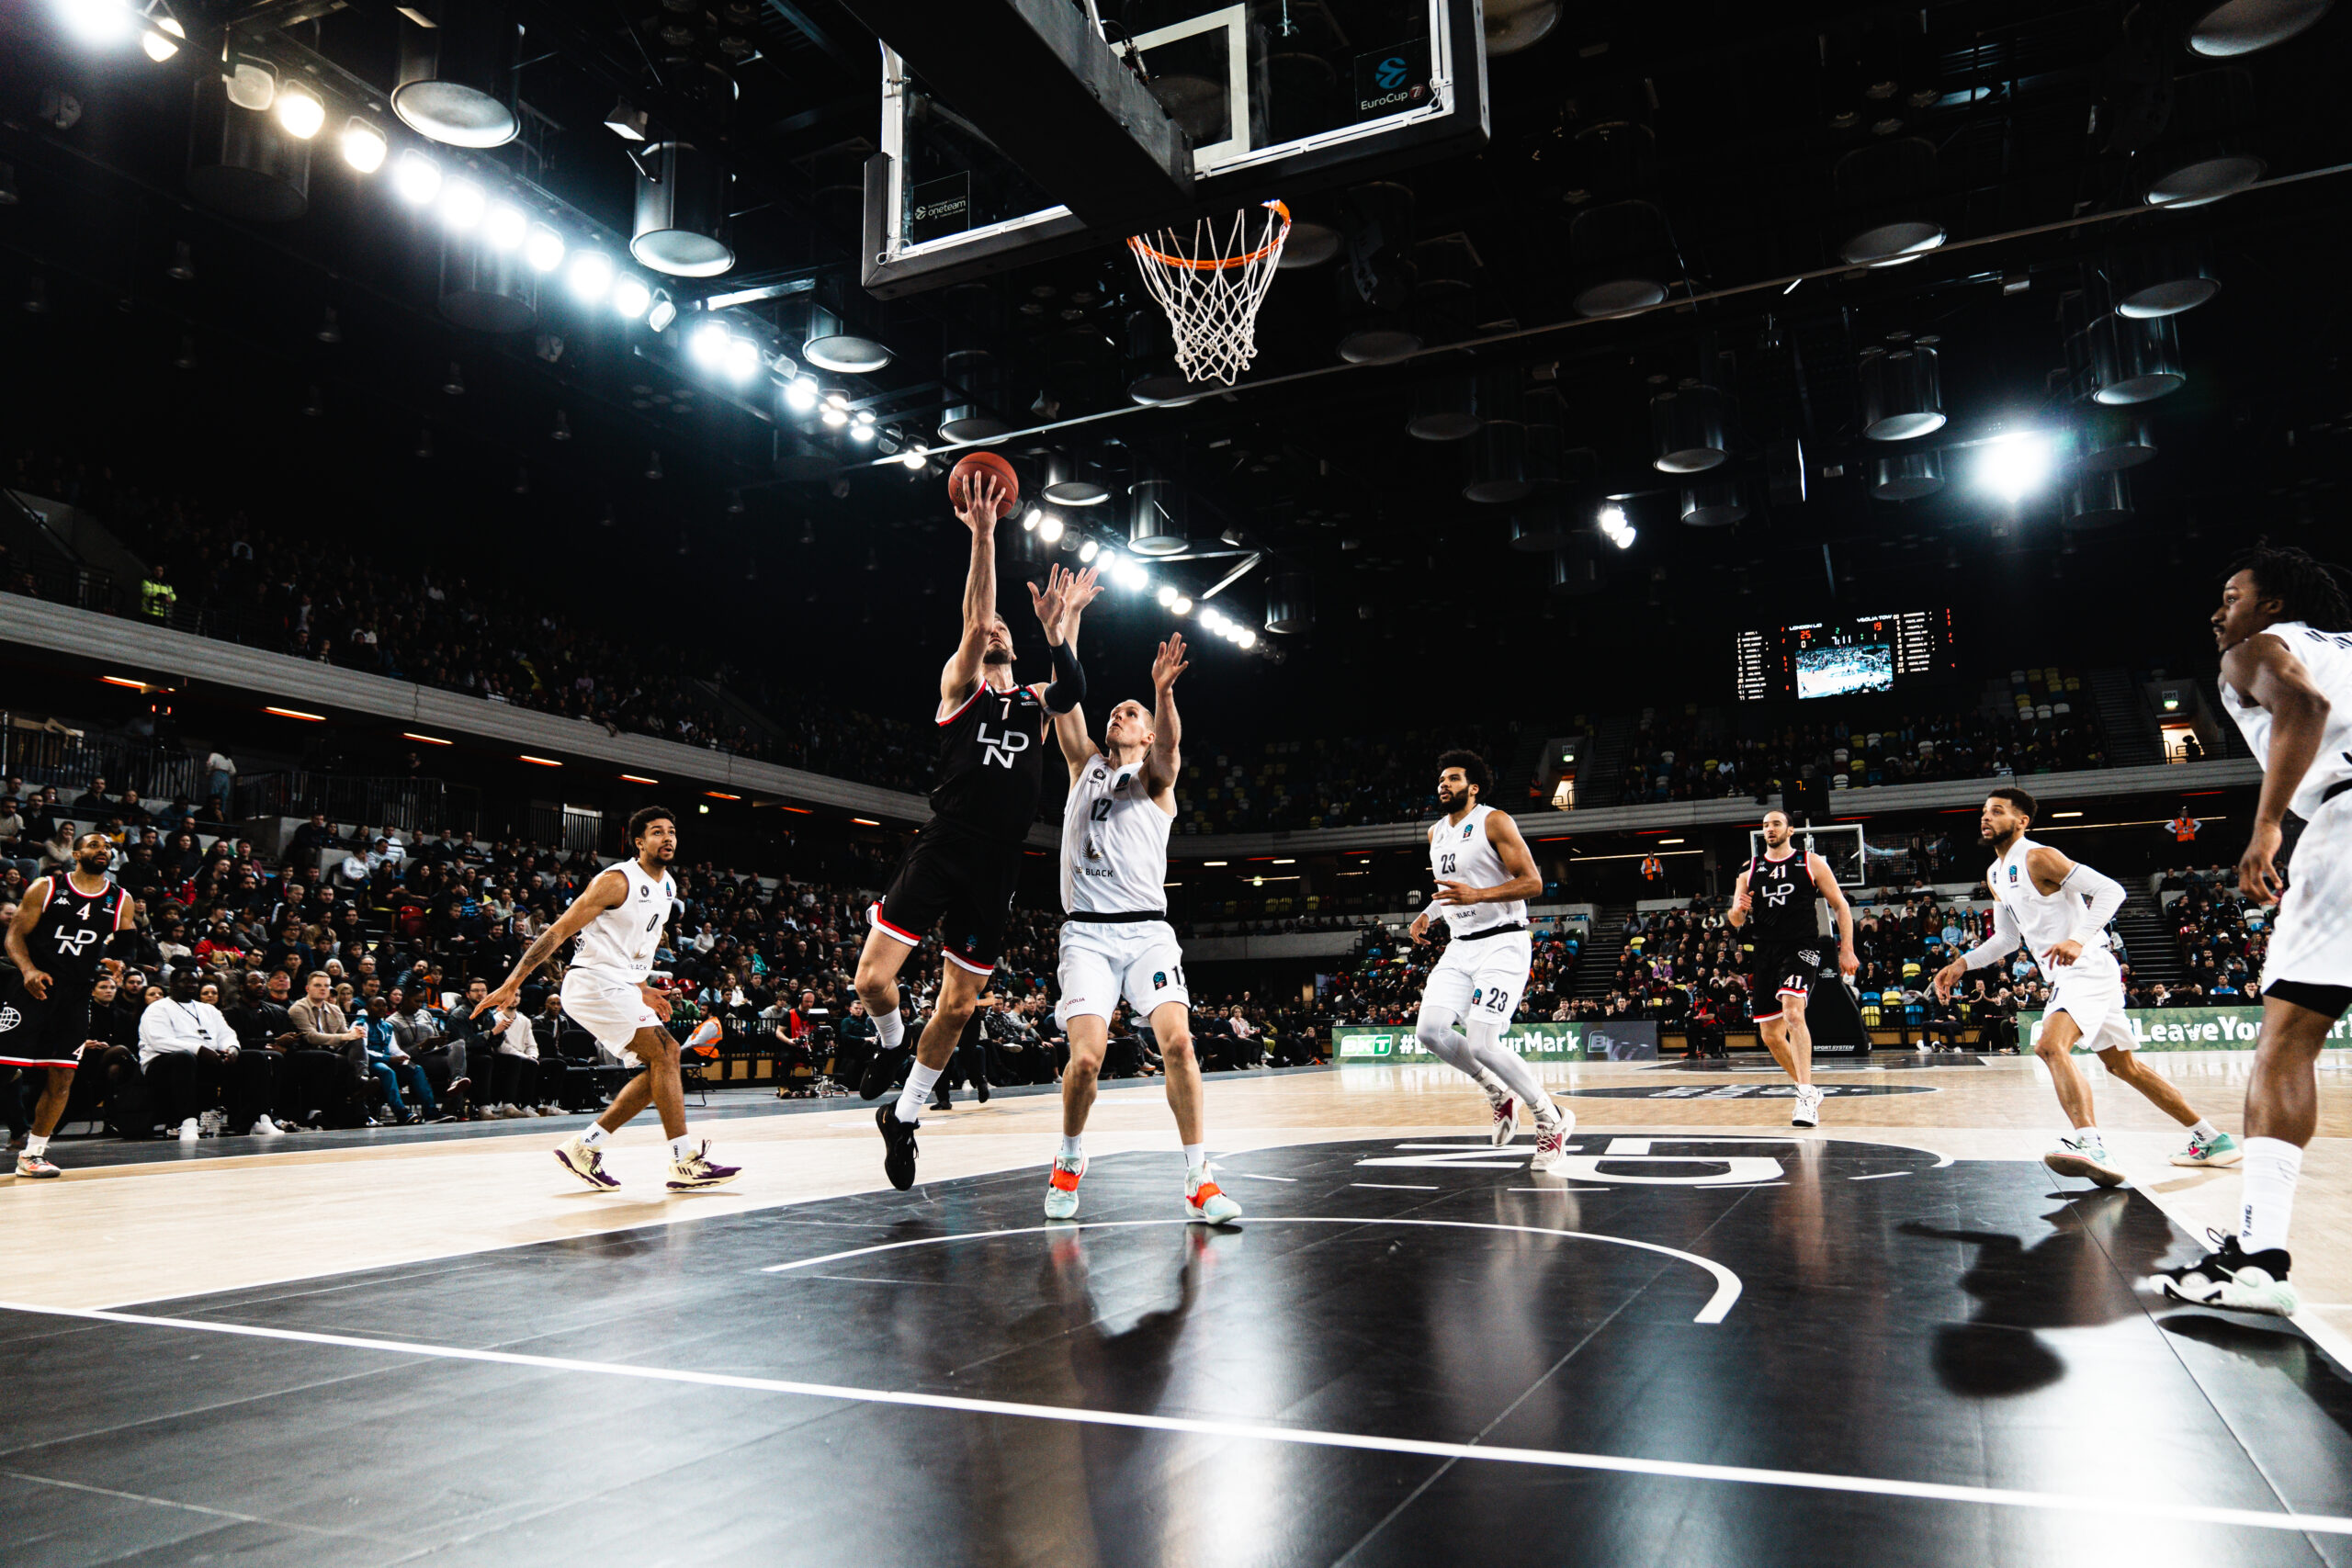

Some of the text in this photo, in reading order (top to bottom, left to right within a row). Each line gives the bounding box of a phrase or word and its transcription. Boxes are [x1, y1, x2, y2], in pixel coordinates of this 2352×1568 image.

[1361, 92, 1408, 110] EuroCup
[928, 200, 966, 216] oneteam
[1801, 630, 1811, 640] 25
[1874, 621, 1882, 631] 19
[999, 698, 1012, 720] 7
[1090, 798, 1113, 821] 12
[1086, 869, 1113, 877] BLACK
[1441, 853, 1456, 875] 23
[1769, 864, 1786, 879] 41
[76, 902, 90, 920] 4
[646, 914, 659, 932] 0
[1784, 974, 1802, 989] 41
[1486, 987, 1508, 1012] 23
[72, 1042, 86, 1060] 4
[1342, 1035, 1391, 1055] BKT
